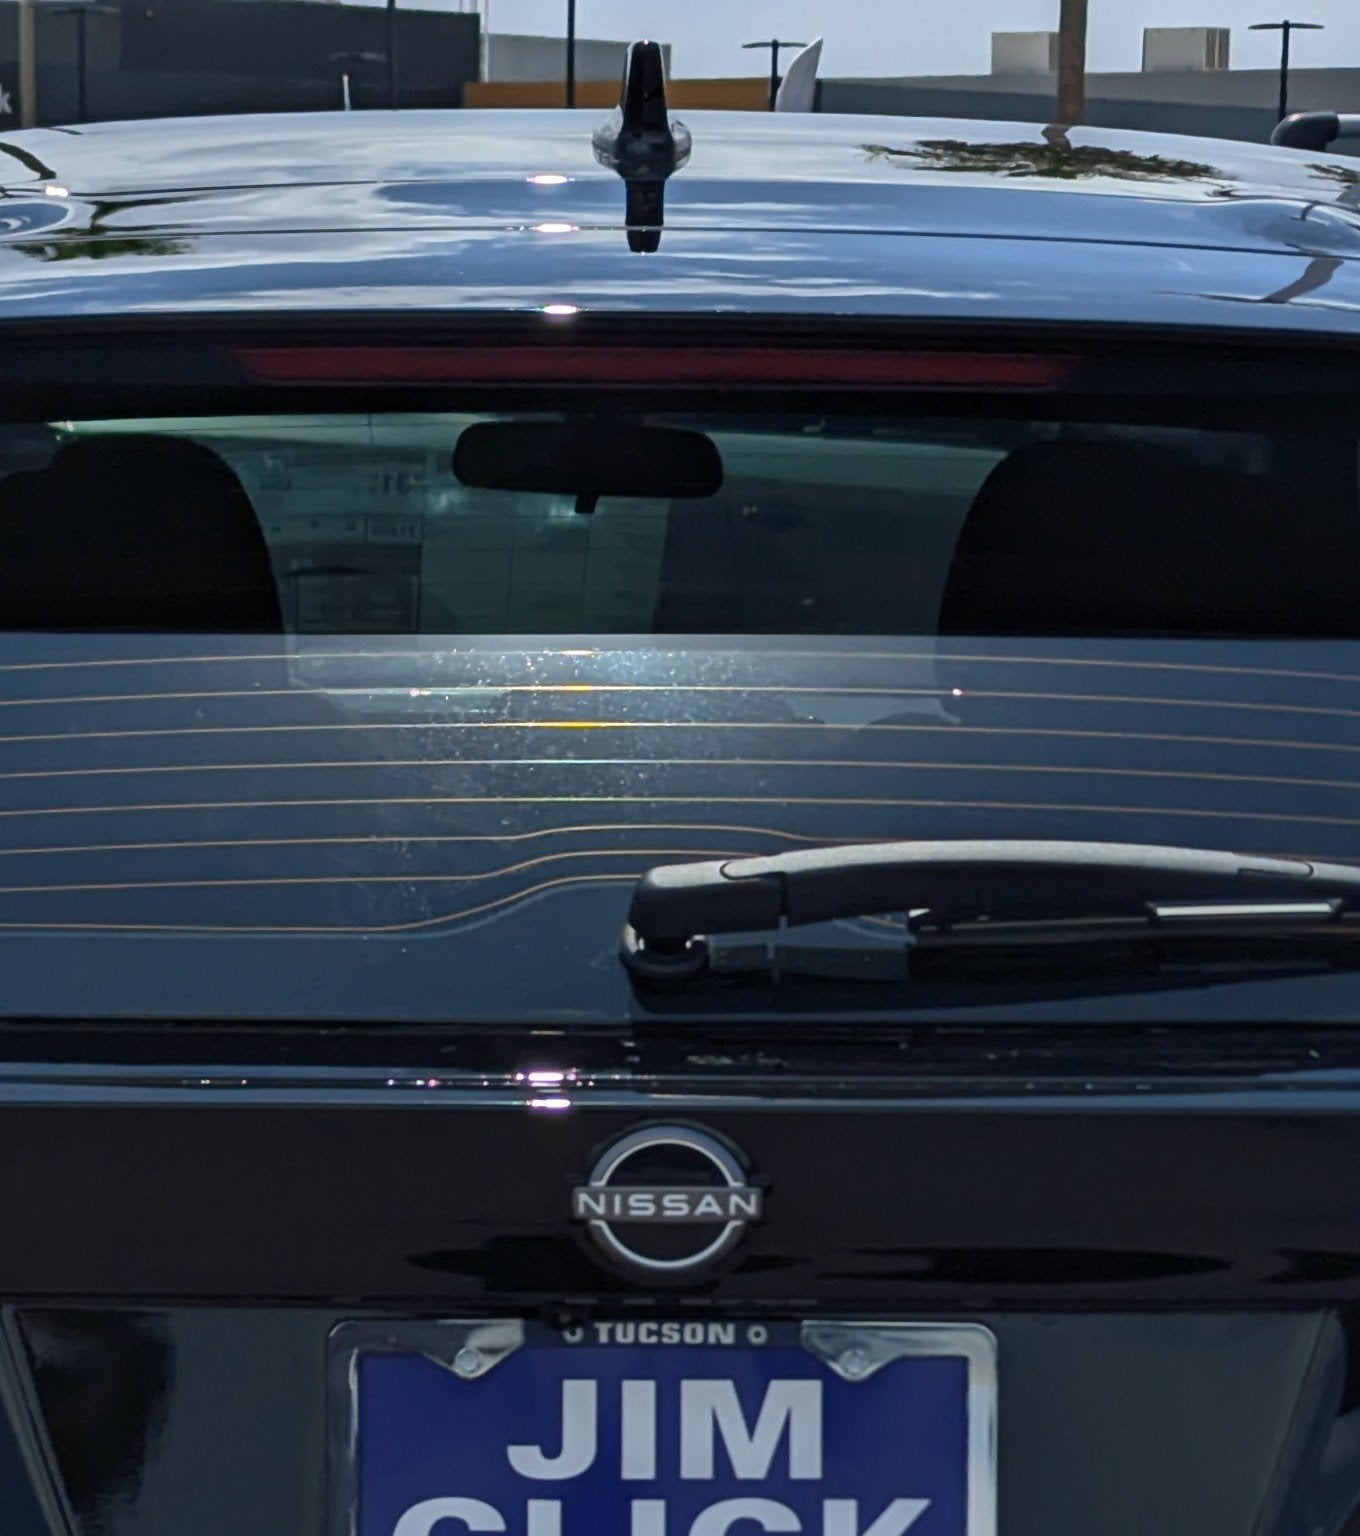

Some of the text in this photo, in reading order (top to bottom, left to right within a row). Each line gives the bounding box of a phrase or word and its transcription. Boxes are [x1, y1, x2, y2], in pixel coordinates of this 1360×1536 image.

[578, 1193, 757, 1216] NISSAN
[595, 1322, 736, 1345] TUCSON
[507, 1379, 823, 1480] JIM
